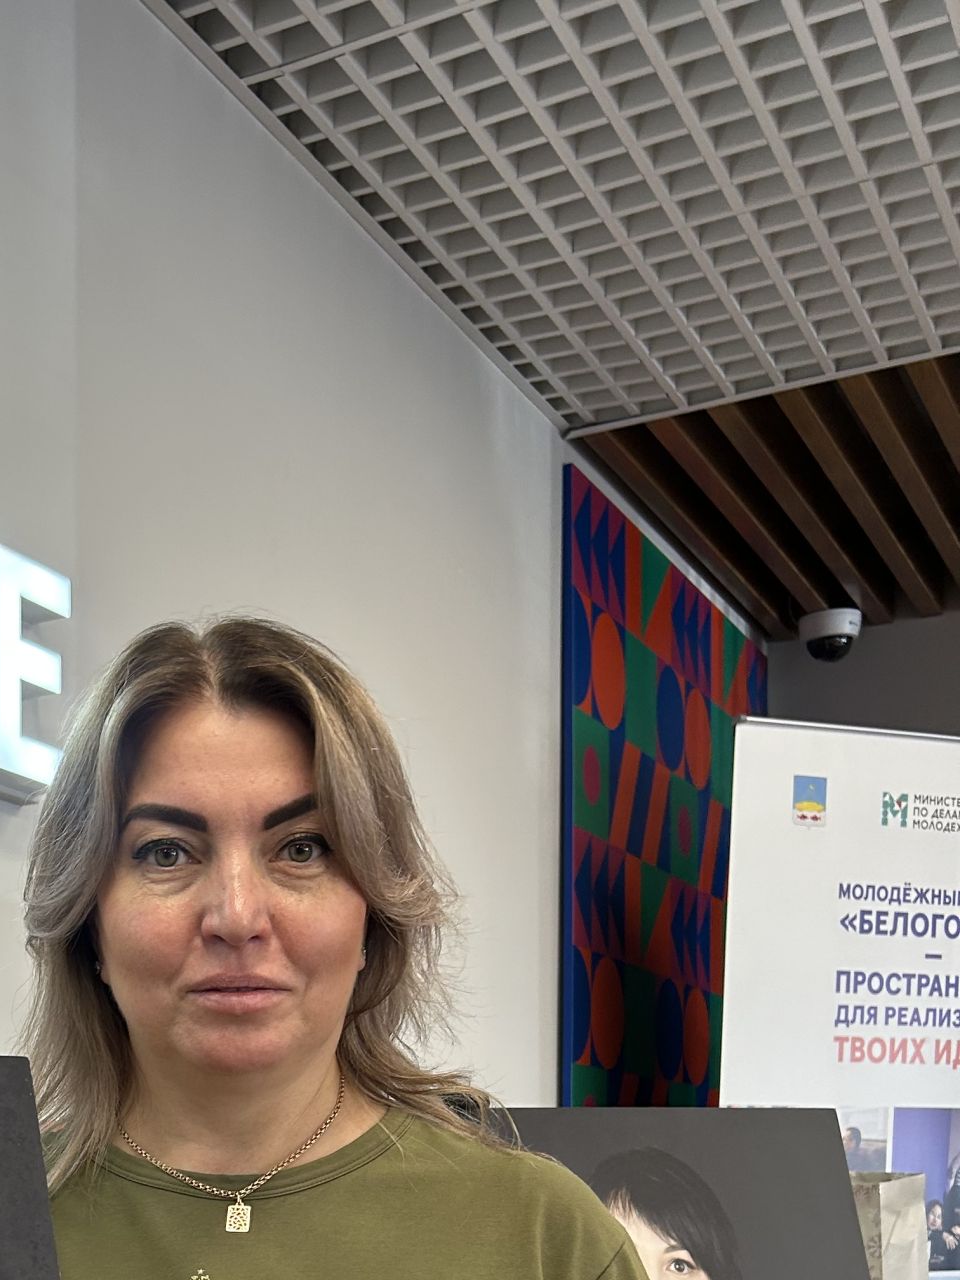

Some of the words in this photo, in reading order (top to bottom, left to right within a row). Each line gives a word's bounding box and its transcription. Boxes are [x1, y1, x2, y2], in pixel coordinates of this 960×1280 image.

[913, 807, 928, 817] ПО
[931, 809, 960, 820] ДЕЛА
[838, 882, 960, 906] МОЛОДЁЖНЫ
[840, 910, 960, 939] «БЕЛОГО
[835, 970, 959, 998] ПРОСТРАН
[835, 1005, 878, 1028] ДЛЯ
[833, 1036, 925, 1065] ТВОИХ
